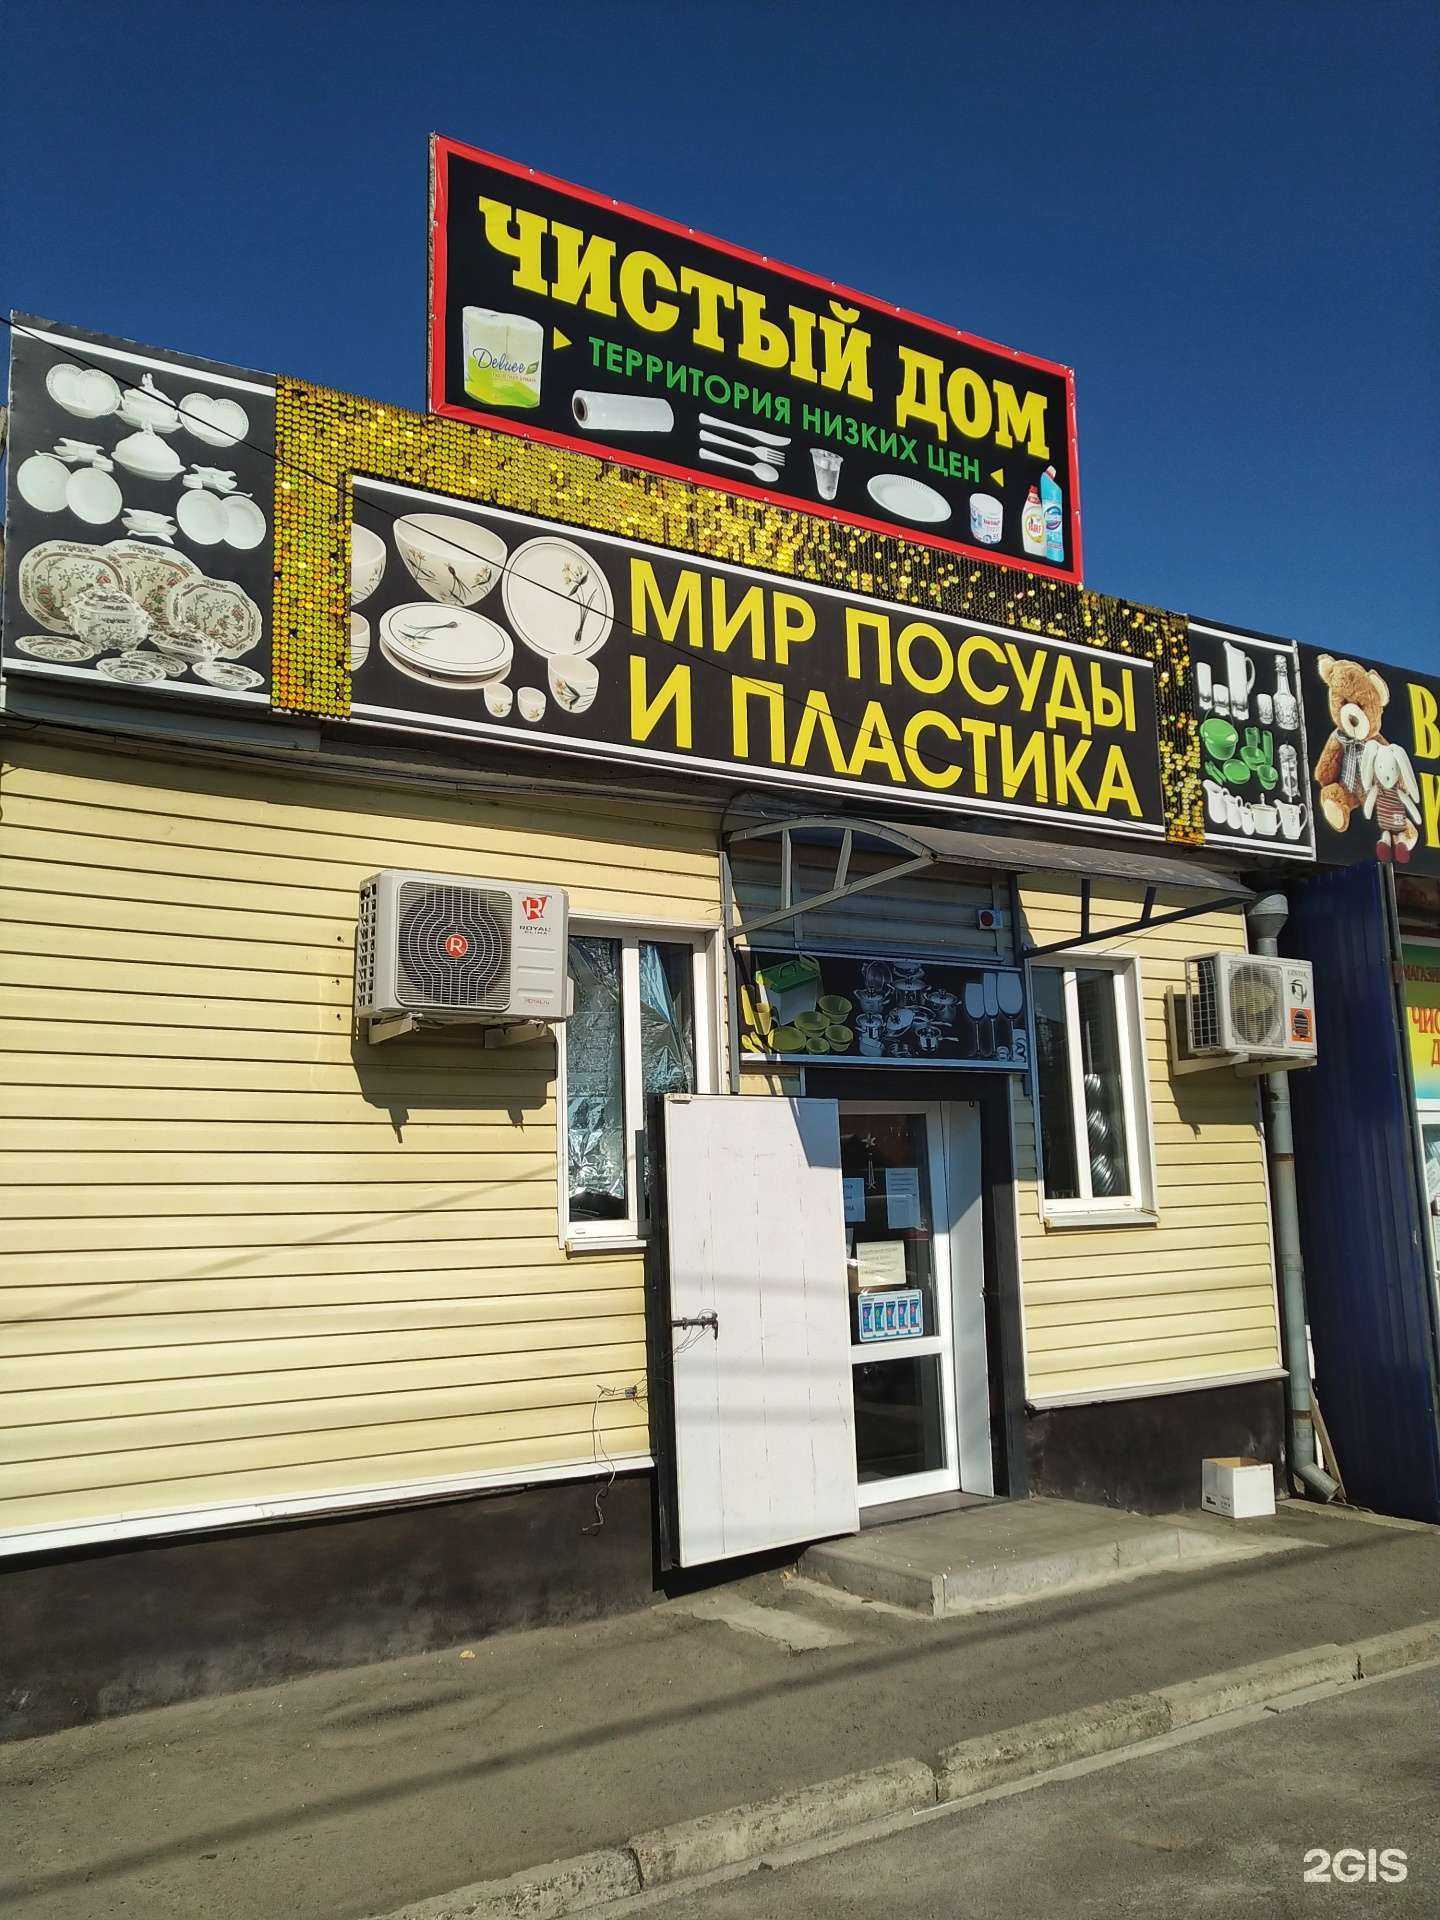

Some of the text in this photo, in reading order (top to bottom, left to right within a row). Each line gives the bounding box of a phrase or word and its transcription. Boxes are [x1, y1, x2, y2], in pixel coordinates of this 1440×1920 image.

[478, 195, 1050, 461] ЧИСТЫЙ ДОМ
[588, 336, 981, 483] ТЕРРИТОРИЯ НИЗКИХ ЦЕН
[630, 558, 1137, 735] МИР ПОСУДЫ
[629, 654, 1143, 817] И ПЛАСТИКА
